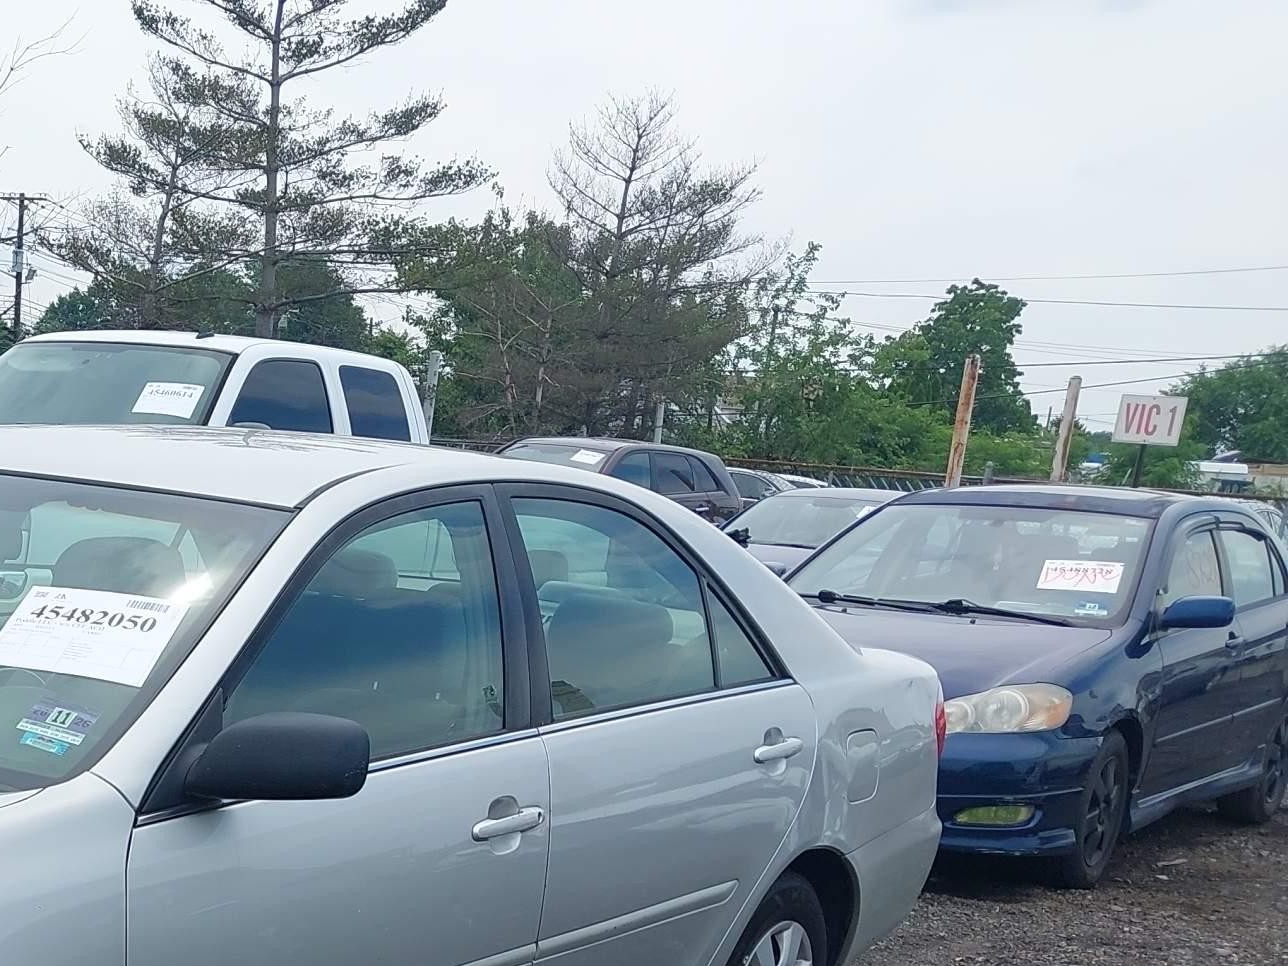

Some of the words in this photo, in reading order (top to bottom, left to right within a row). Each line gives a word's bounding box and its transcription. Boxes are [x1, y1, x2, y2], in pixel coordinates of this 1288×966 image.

[1124, 402, 1161, 437] VIC
[1167, 405, 1179, 437] 1
[30, 604, 158, 633] 45482050
[51, 710, 72, 726] 11
